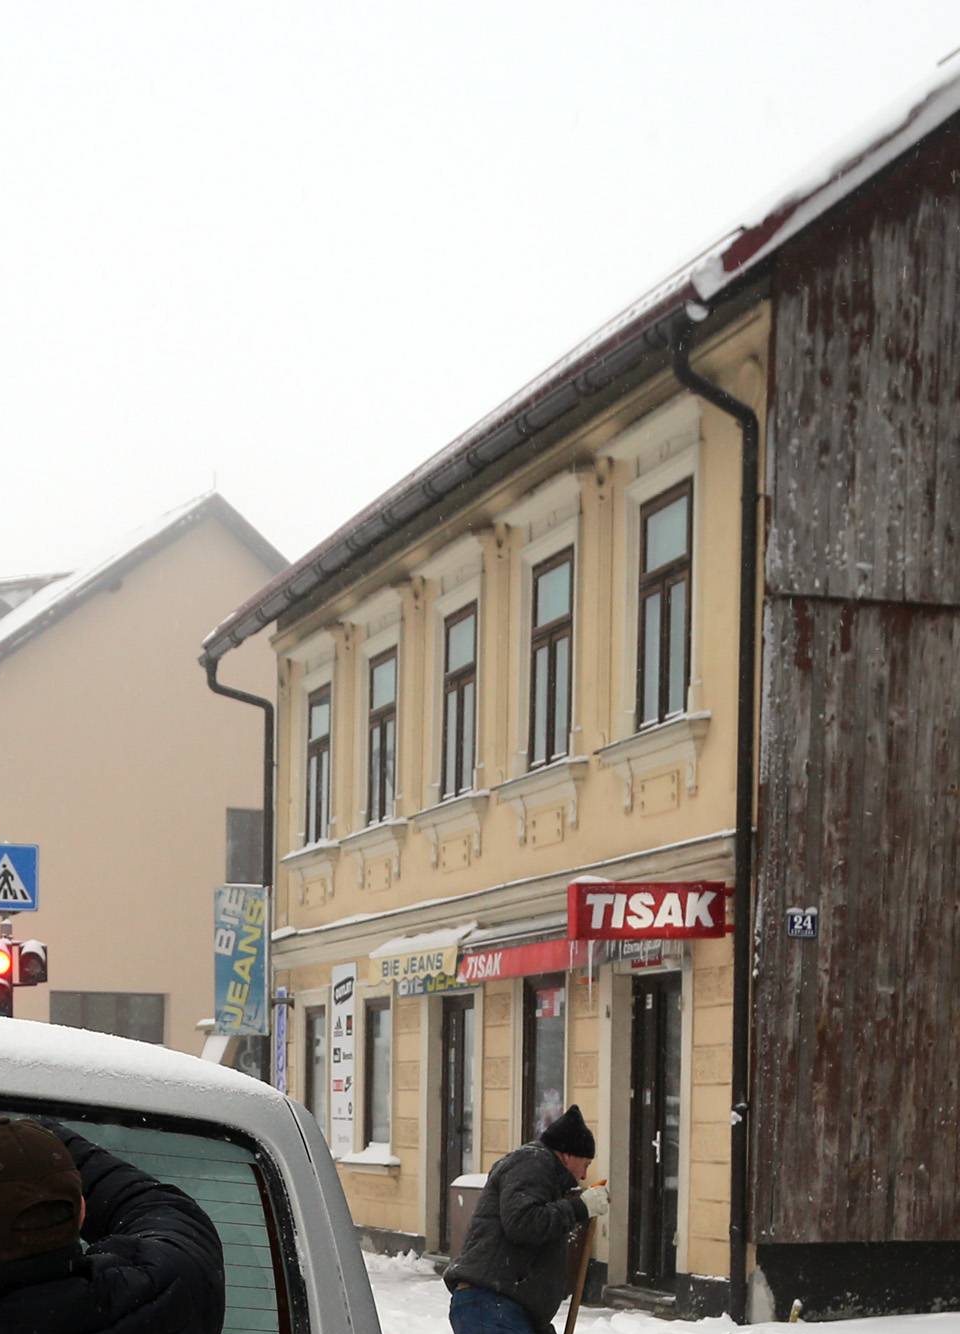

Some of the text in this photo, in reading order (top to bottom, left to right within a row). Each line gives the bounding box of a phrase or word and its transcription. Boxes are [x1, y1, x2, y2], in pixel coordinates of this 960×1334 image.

[215, 887, 246, 956] BIE
[585, 890, 719, 930] TISAK
[793, 914, 812, 930] 24
[223, 897, 265, 1030] JEANS
[381, 953, 444, 977] BIE JEANS
[465, 952, 503, 979] TISAK
